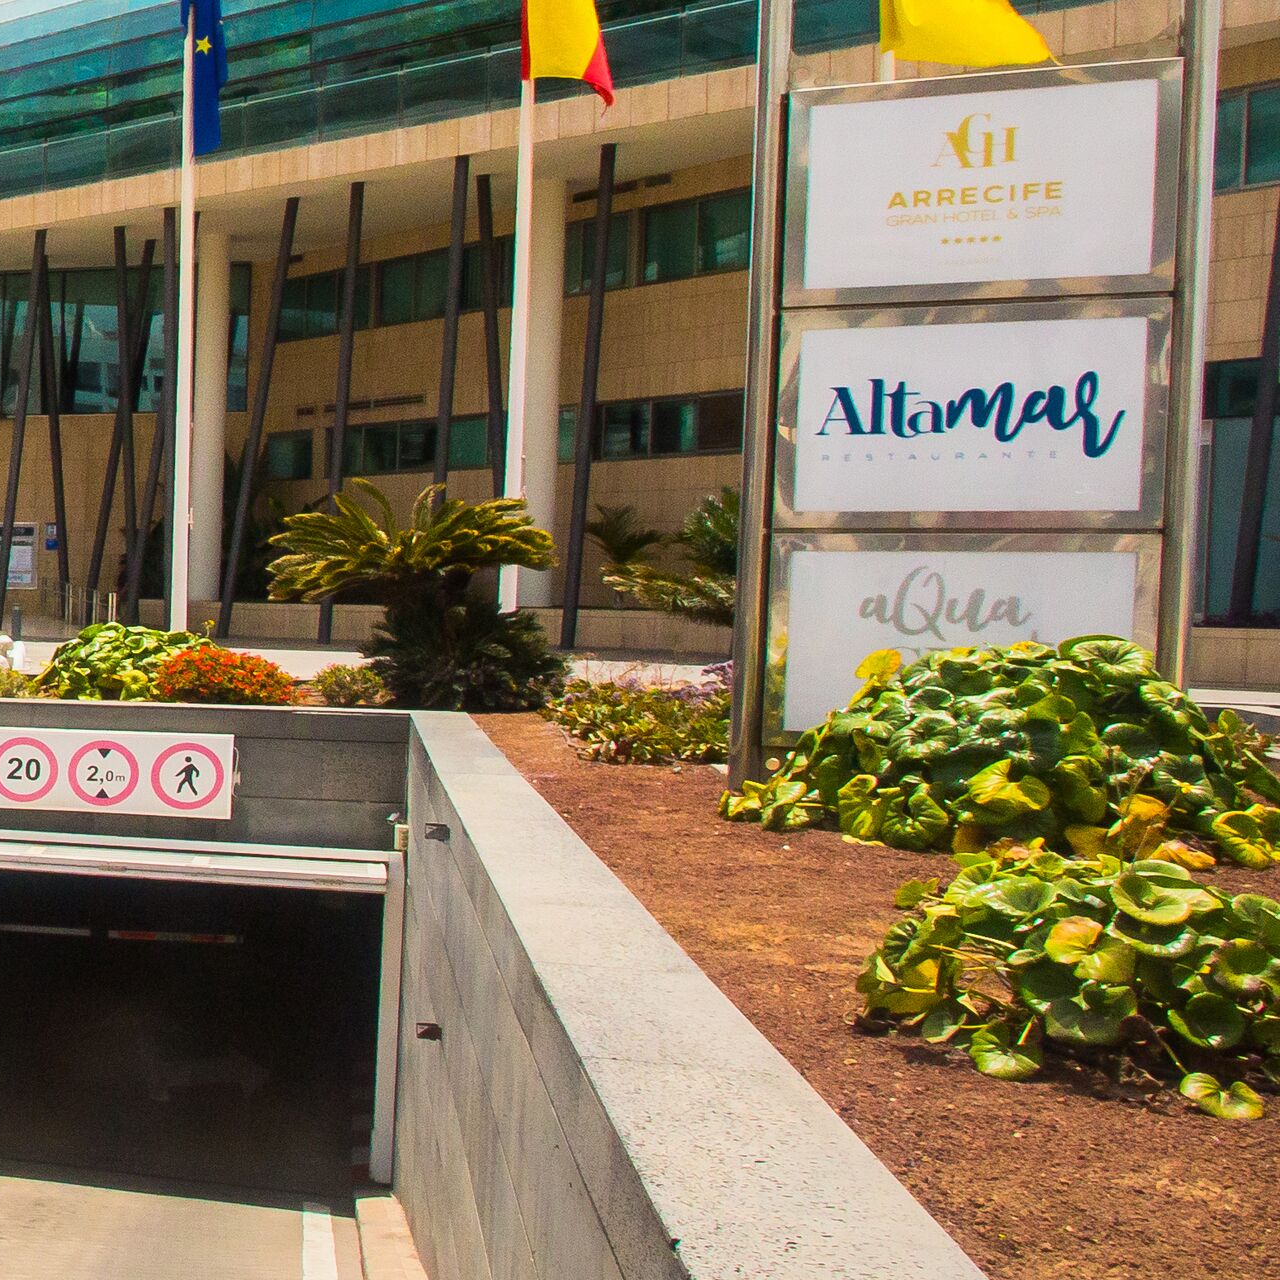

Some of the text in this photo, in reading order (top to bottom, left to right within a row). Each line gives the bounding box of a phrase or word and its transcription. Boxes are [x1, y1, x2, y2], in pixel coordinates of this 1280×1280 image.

[887, 181, 1063, 209] ARRECIFE
[886, 206, 1061, 227] GRAN HOTEL & SPA
[814, 371, 1126, 458] Altamar
[821, 450, 1057, 462] RESTAURANTE
[6, 757, 41, 781] 20
